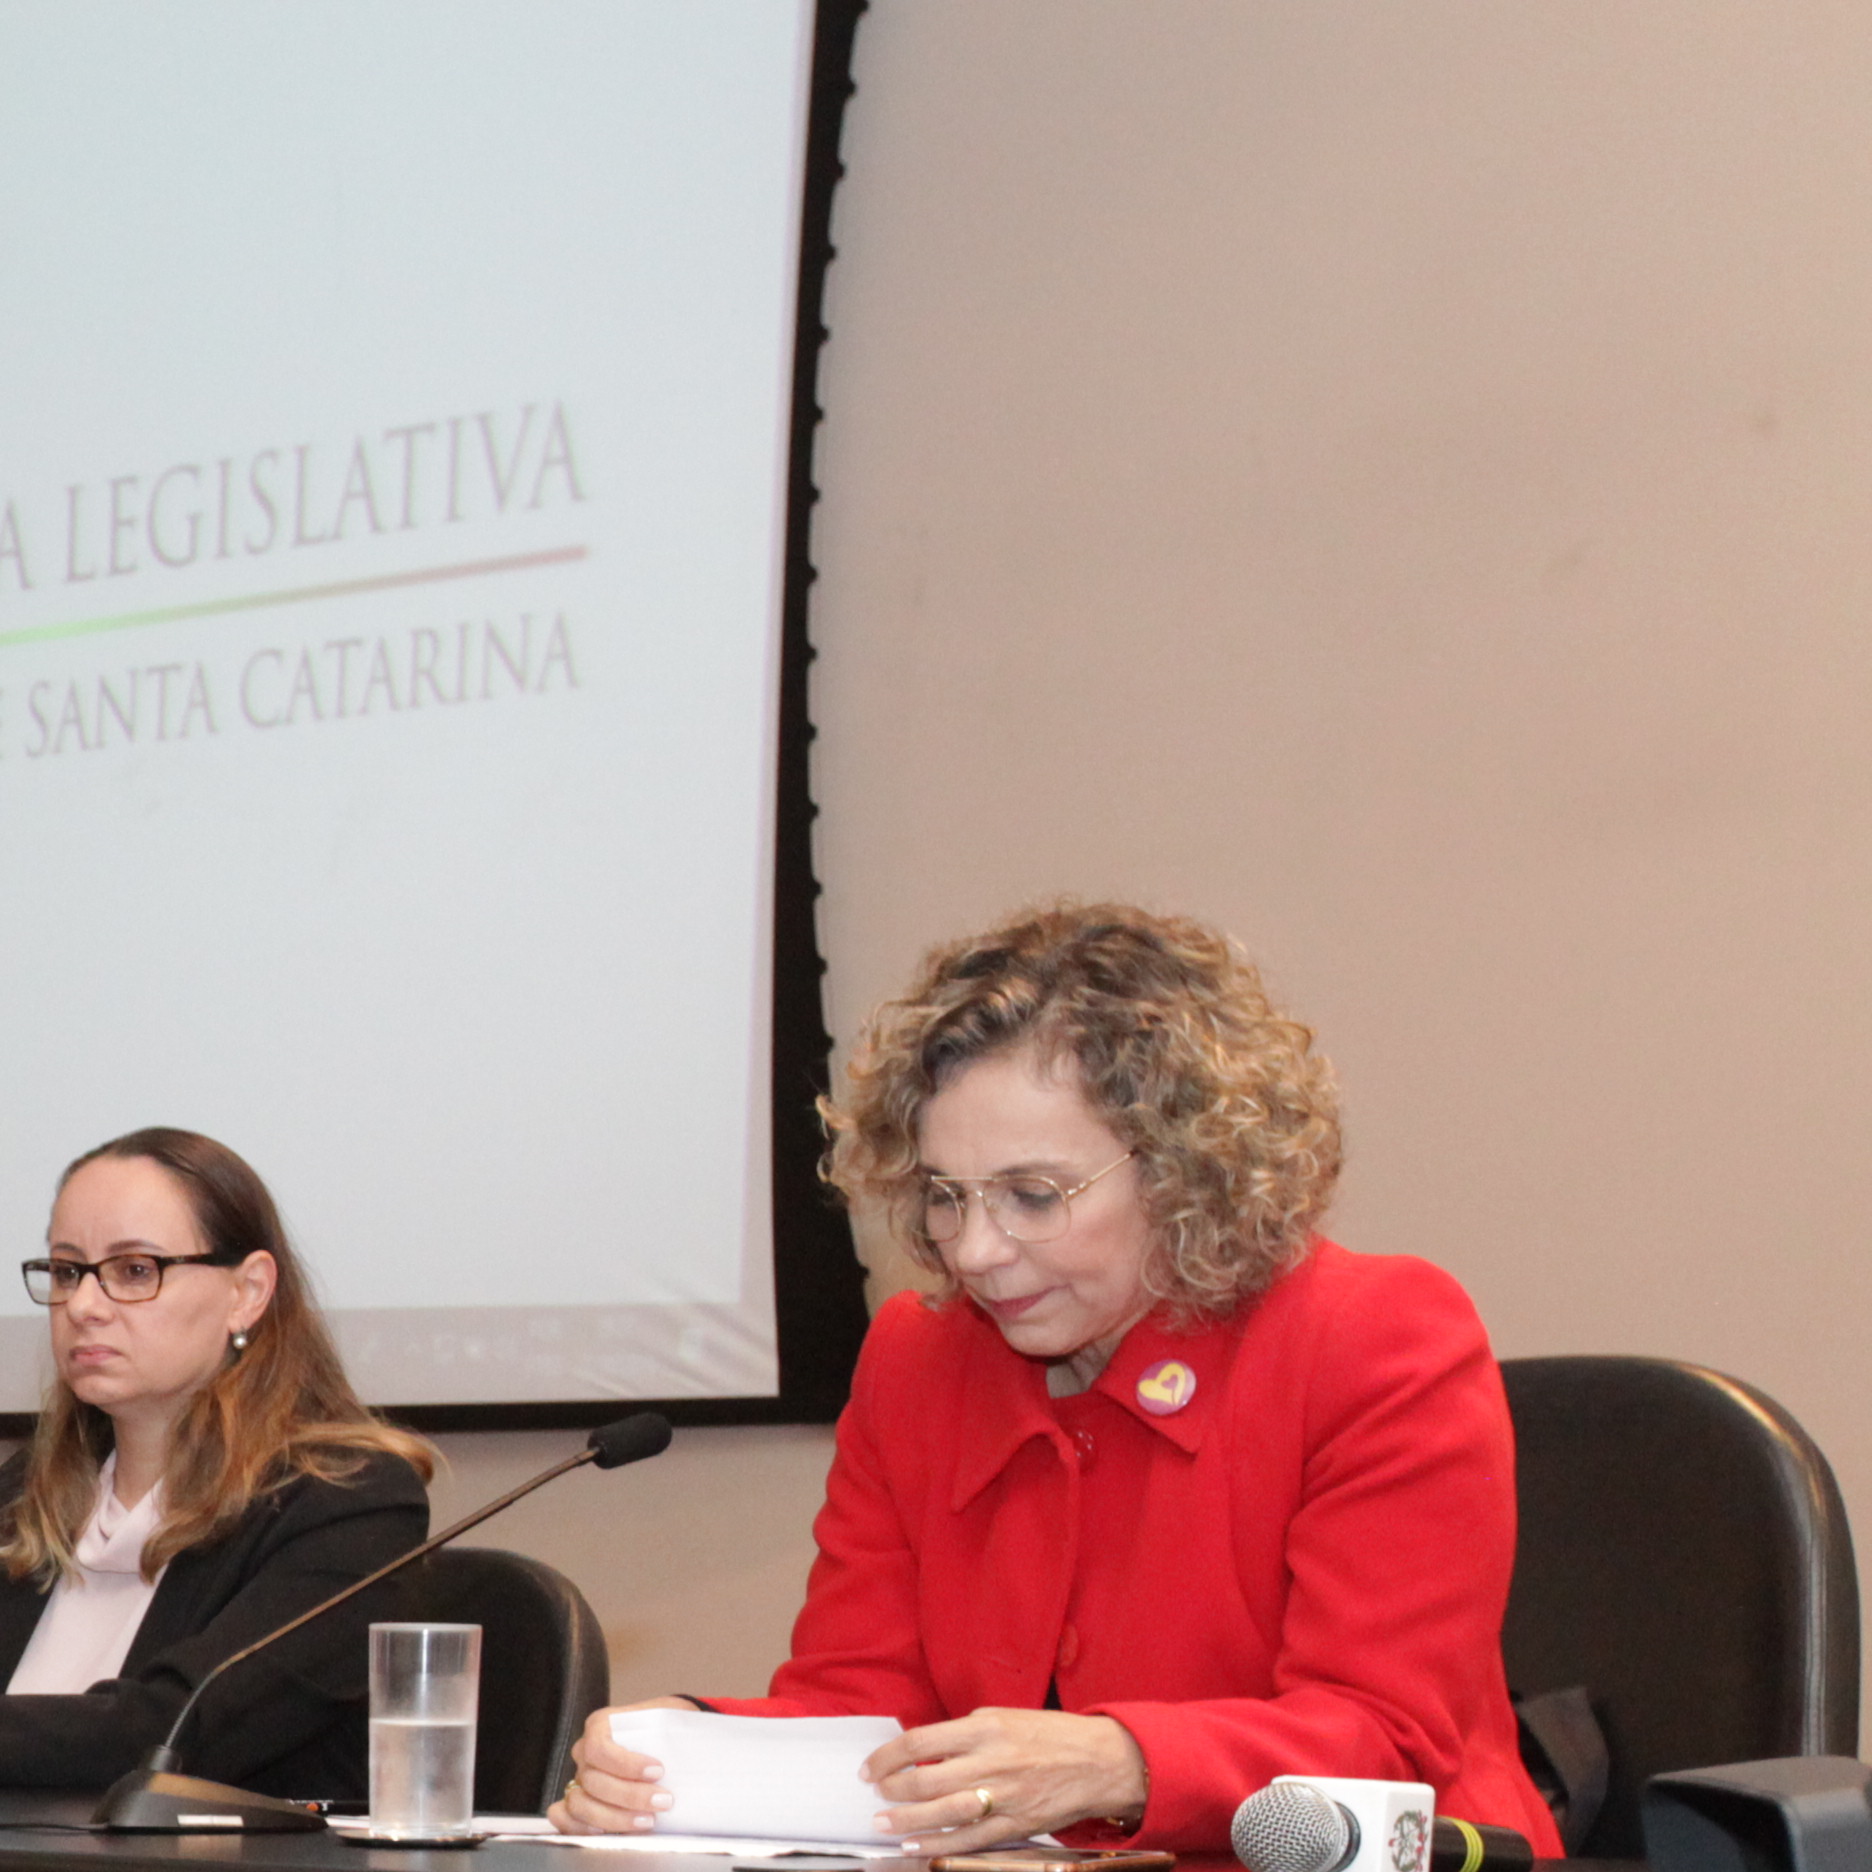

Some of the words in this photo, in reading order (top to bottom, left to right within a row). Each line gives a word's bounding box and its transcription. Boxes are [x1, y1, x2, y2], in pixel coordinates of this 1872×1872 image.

[64, 400, 587, 583] LEGISLATIVA
[25, 661, 219, 759] SANTA
[238, 612, 580, 729] CATARINA
